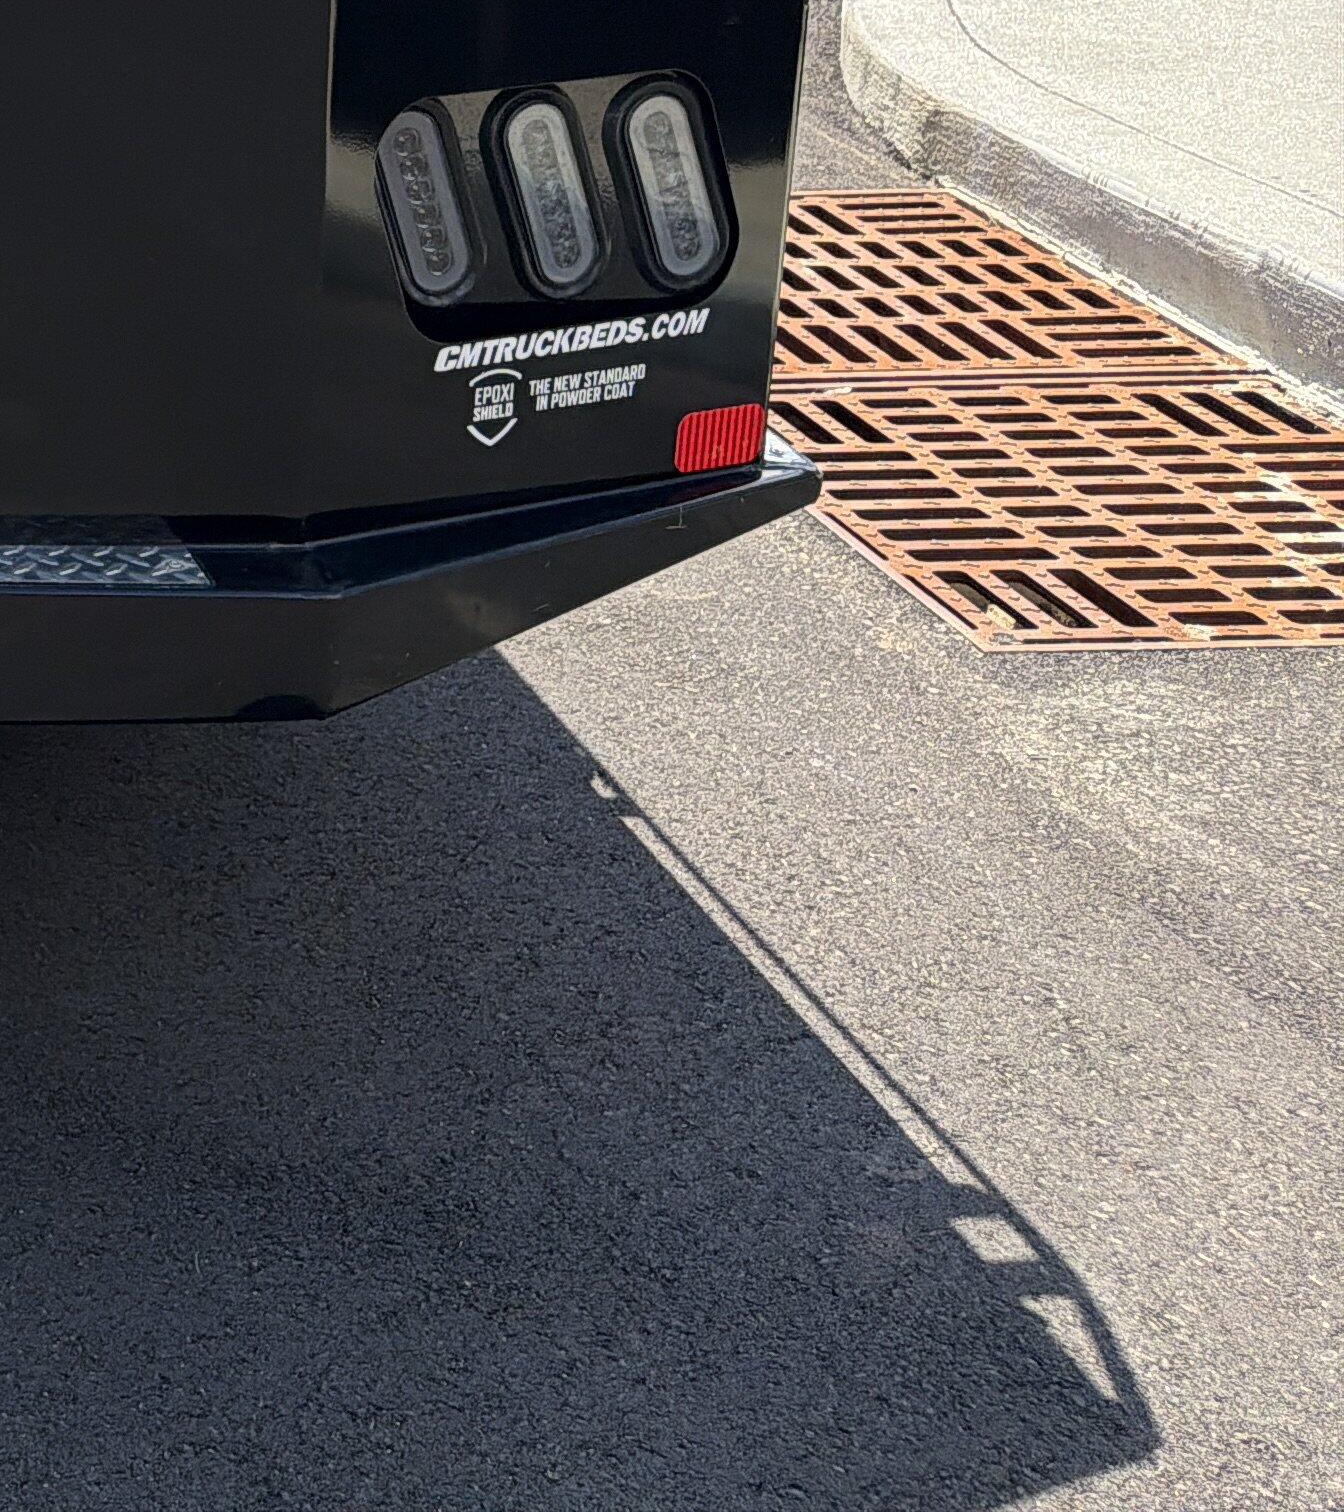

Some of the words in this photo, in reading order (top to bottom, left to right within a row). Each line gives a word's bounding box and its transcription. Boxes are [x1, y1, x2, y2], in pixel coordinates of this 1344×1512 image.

[433, 307, 711, 373] CMTRUCKBEDS.COM
[474, 382, 515, 407] EPOXI
[528, 377, 552, 396] THE
[553, 373, 583, 393] NEW
[583, 363, 647, 389] STANDARD
[535, 394, 549, 412] IN
[550, 386, 602, 410] POWDER
[603, 380, 637, 402] COAT
[472, 402, 514, 423] SHIELD
